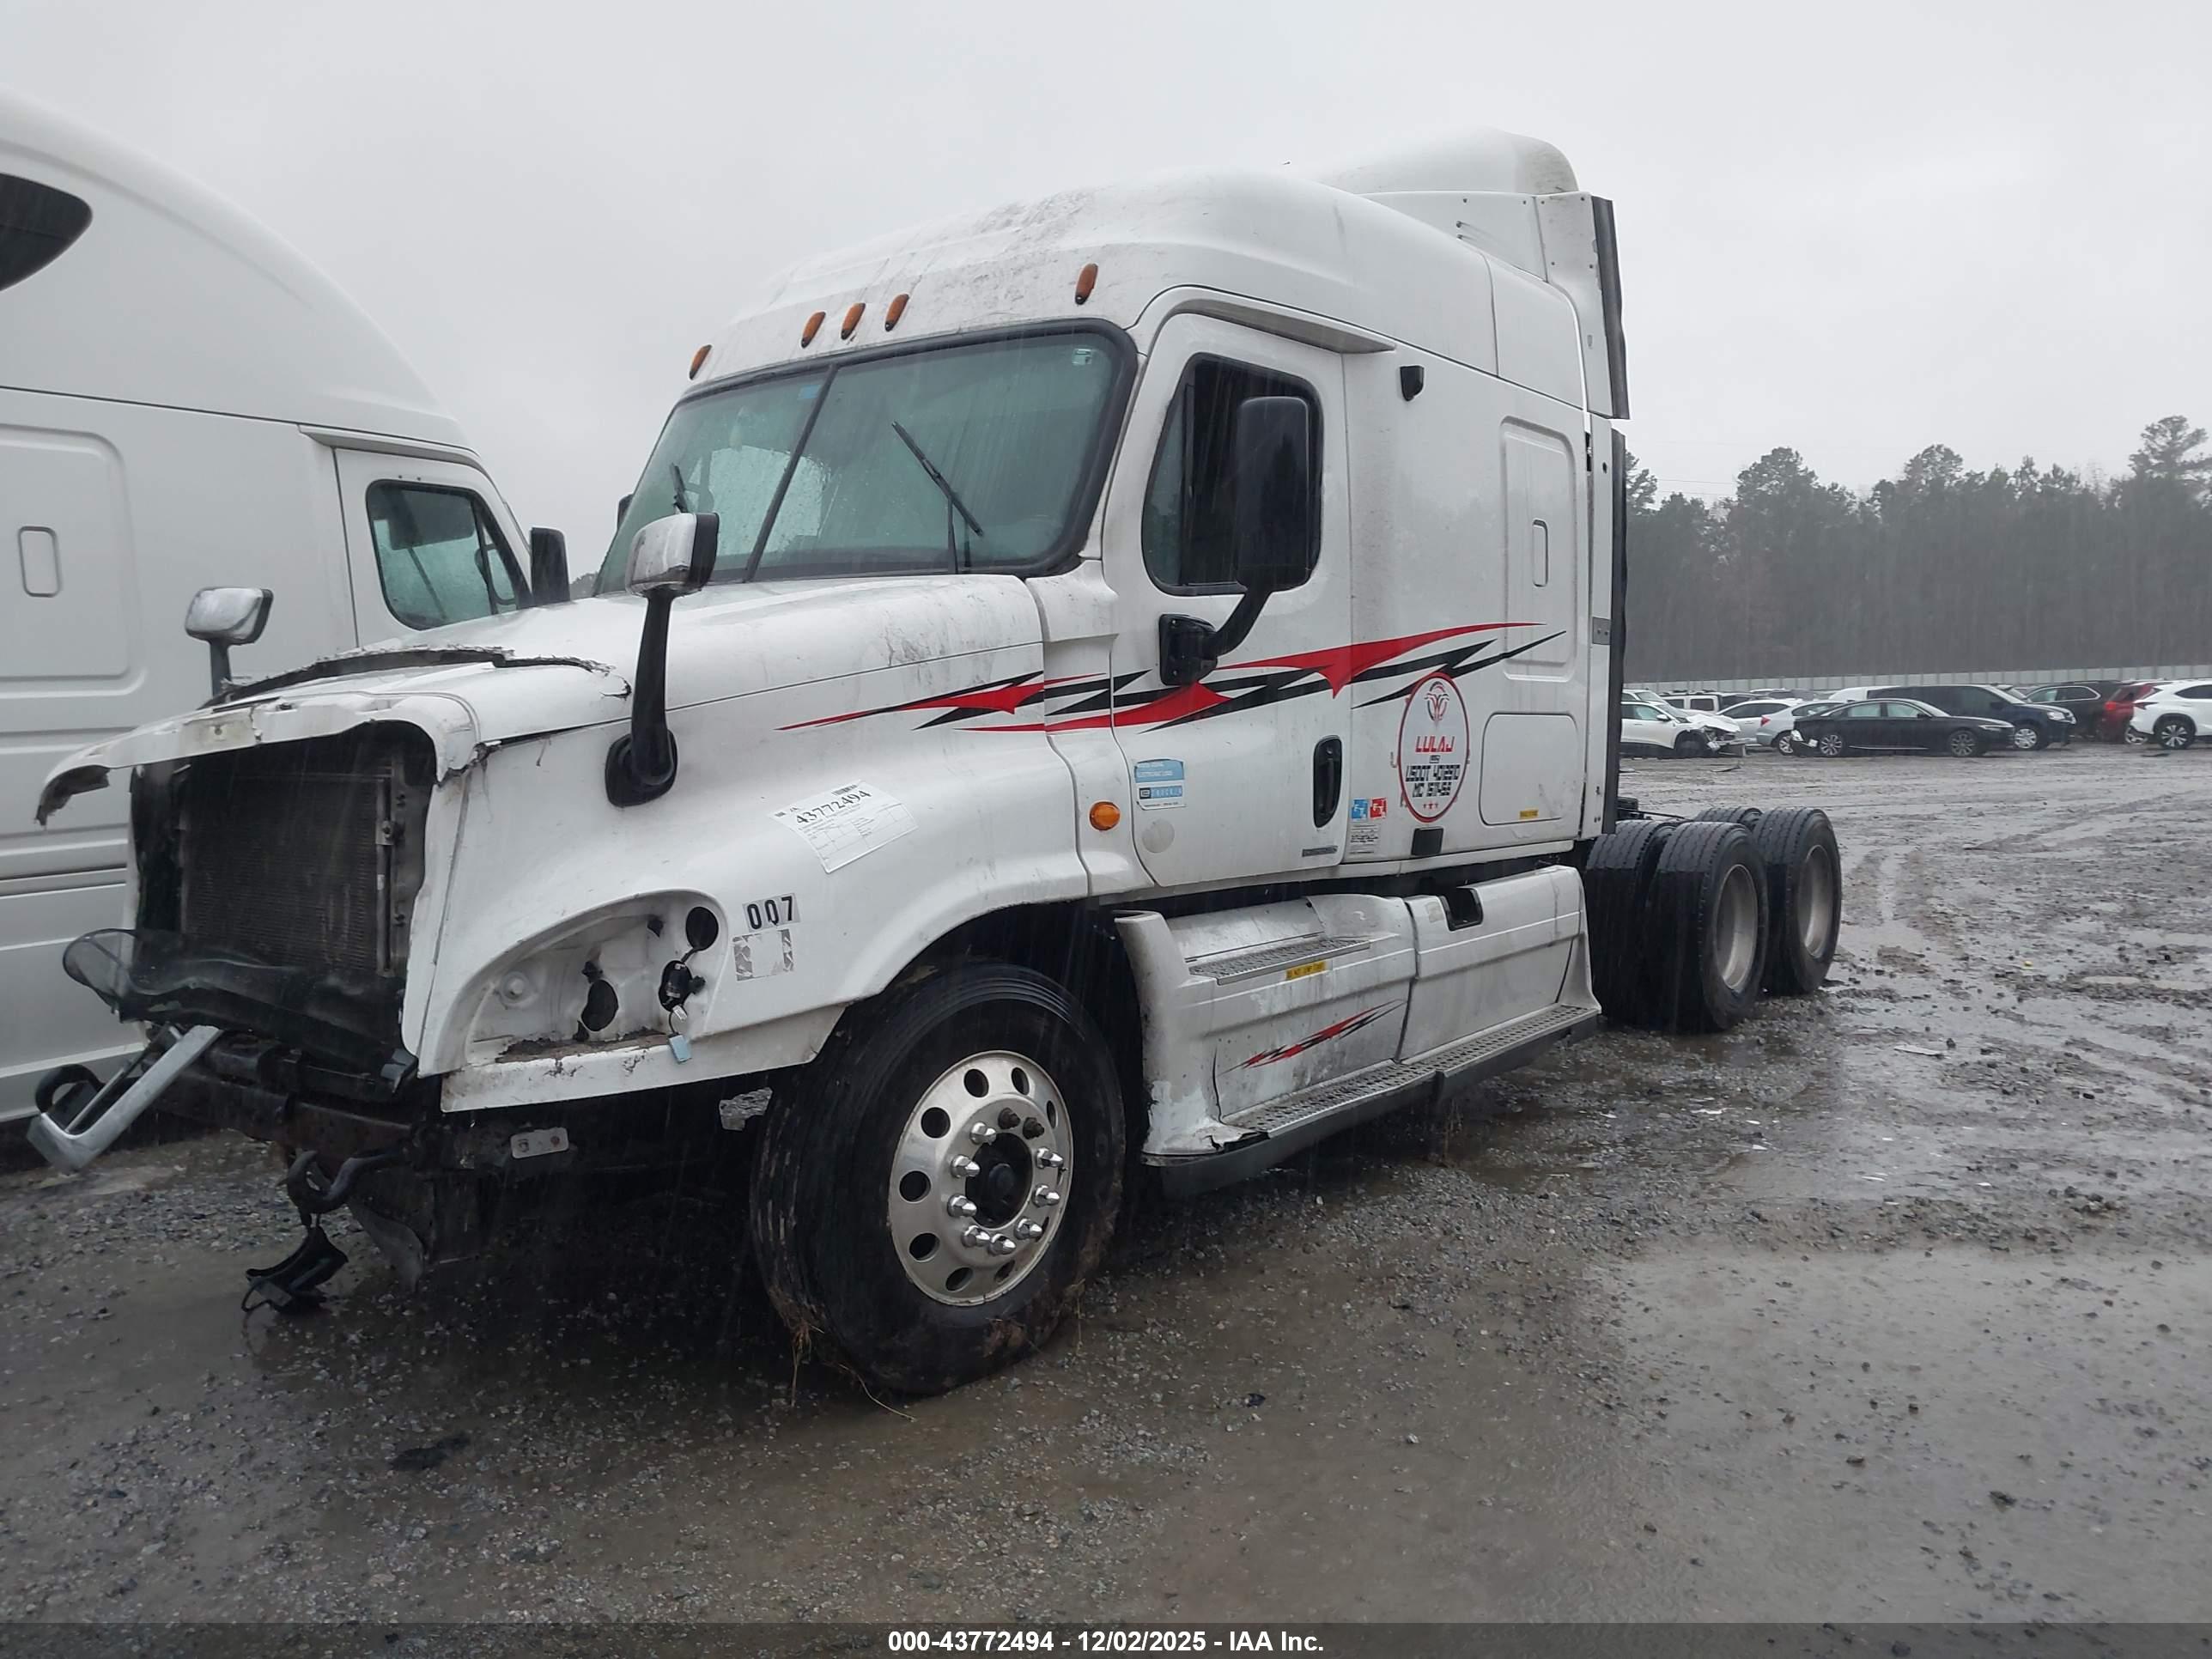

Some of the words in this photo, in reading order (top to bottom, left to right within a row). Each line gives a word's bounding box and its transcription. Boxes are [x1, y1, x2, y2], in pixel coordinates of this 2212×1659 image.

[1415, 736, 1455, 752] LULAJ
[796, 790, 872, 823] 43772494
[747, 896, 793, 929] 007
